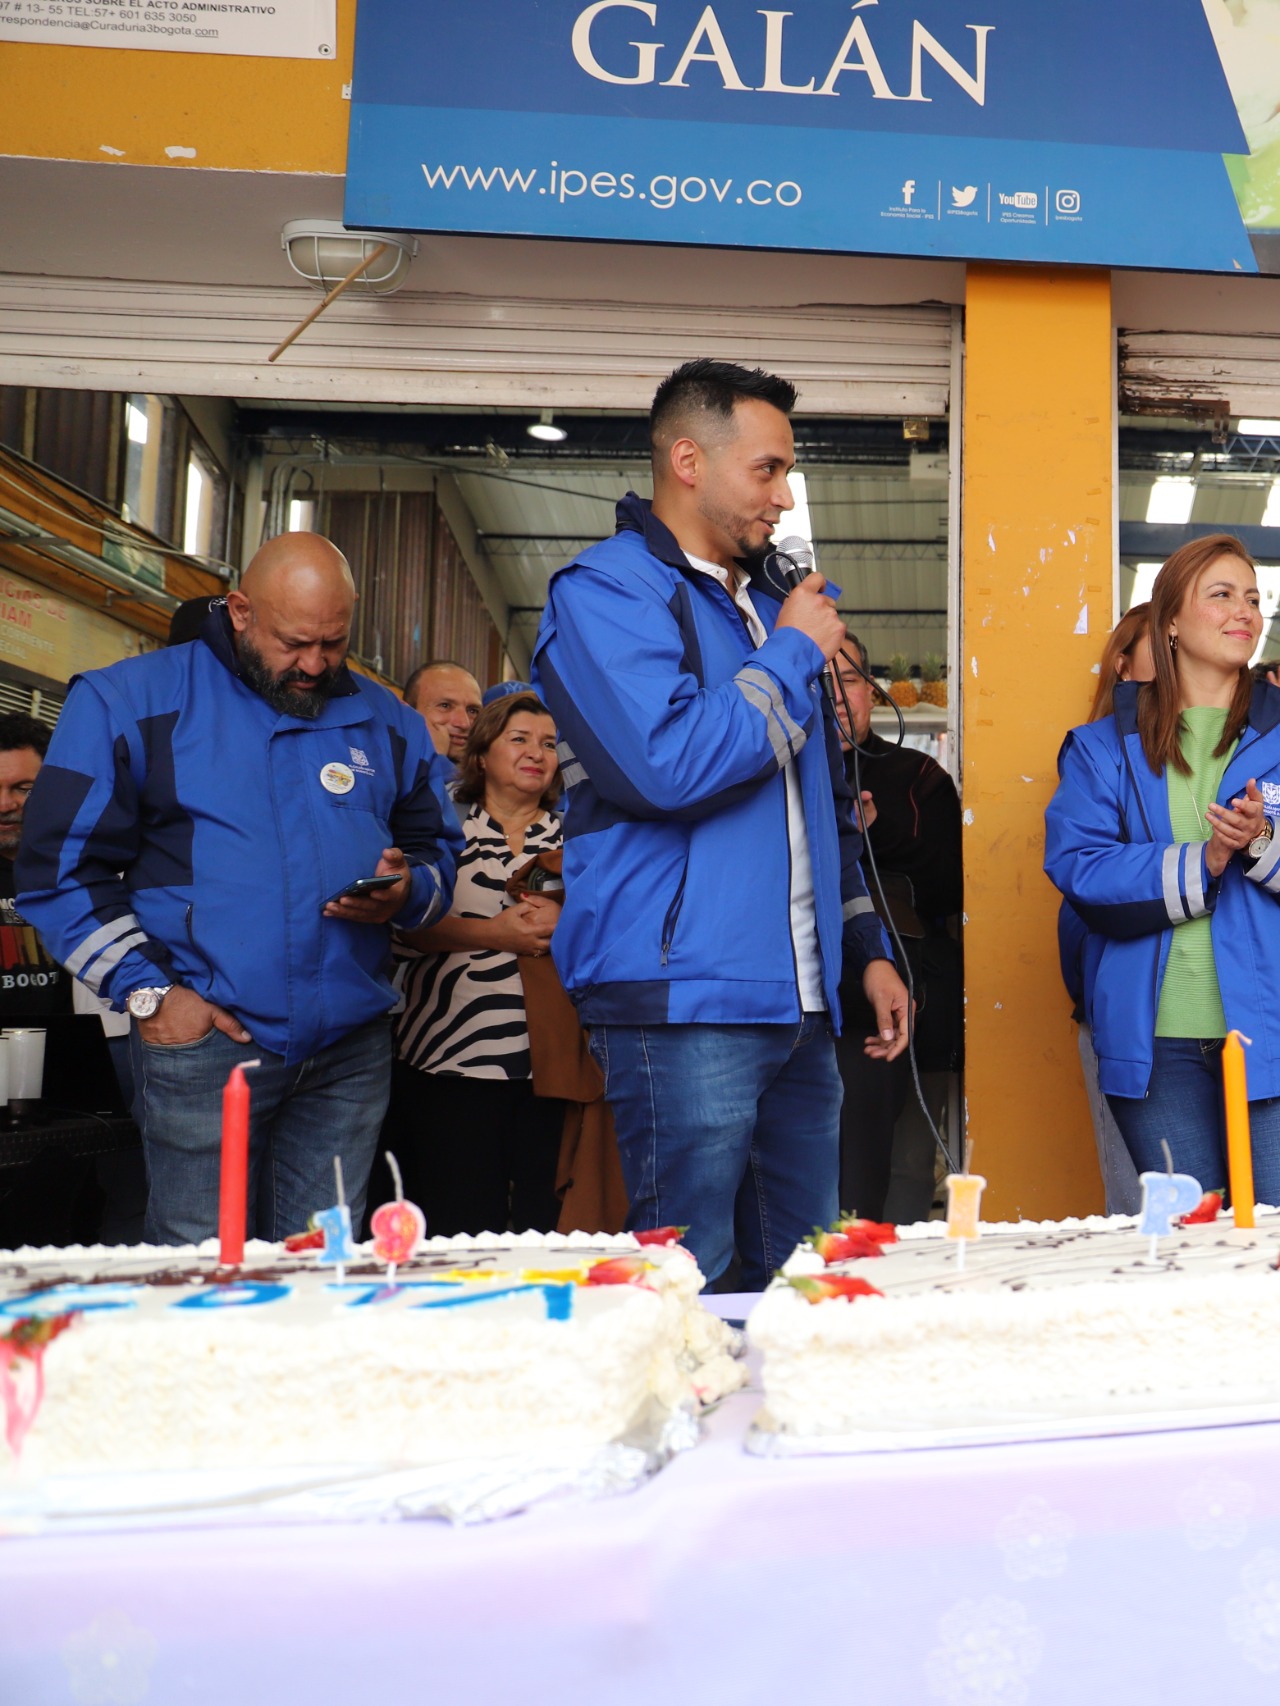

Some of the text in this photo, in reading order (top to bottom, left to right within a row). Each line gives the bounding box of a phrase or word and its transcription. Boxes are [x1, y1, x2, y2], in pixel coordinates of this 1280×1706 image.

[48, 5, 63, 14] 55
[120, 10, 140, 19] 601
[144, 12, 166, 21] 635
[169, 12, 197, 22] 3050
[147, 0, 178, 9] ACTO
[182, 2, 276, 14] ADMINISTRATIVO
[0, 16, 218, 37] respondencia@Curaduria3bogota.com
[572, 0, 996, 106] GALÁN
[421, 160, 802, 209] www.ipes.gov.co
[0, 600, 32, 630] IAM
